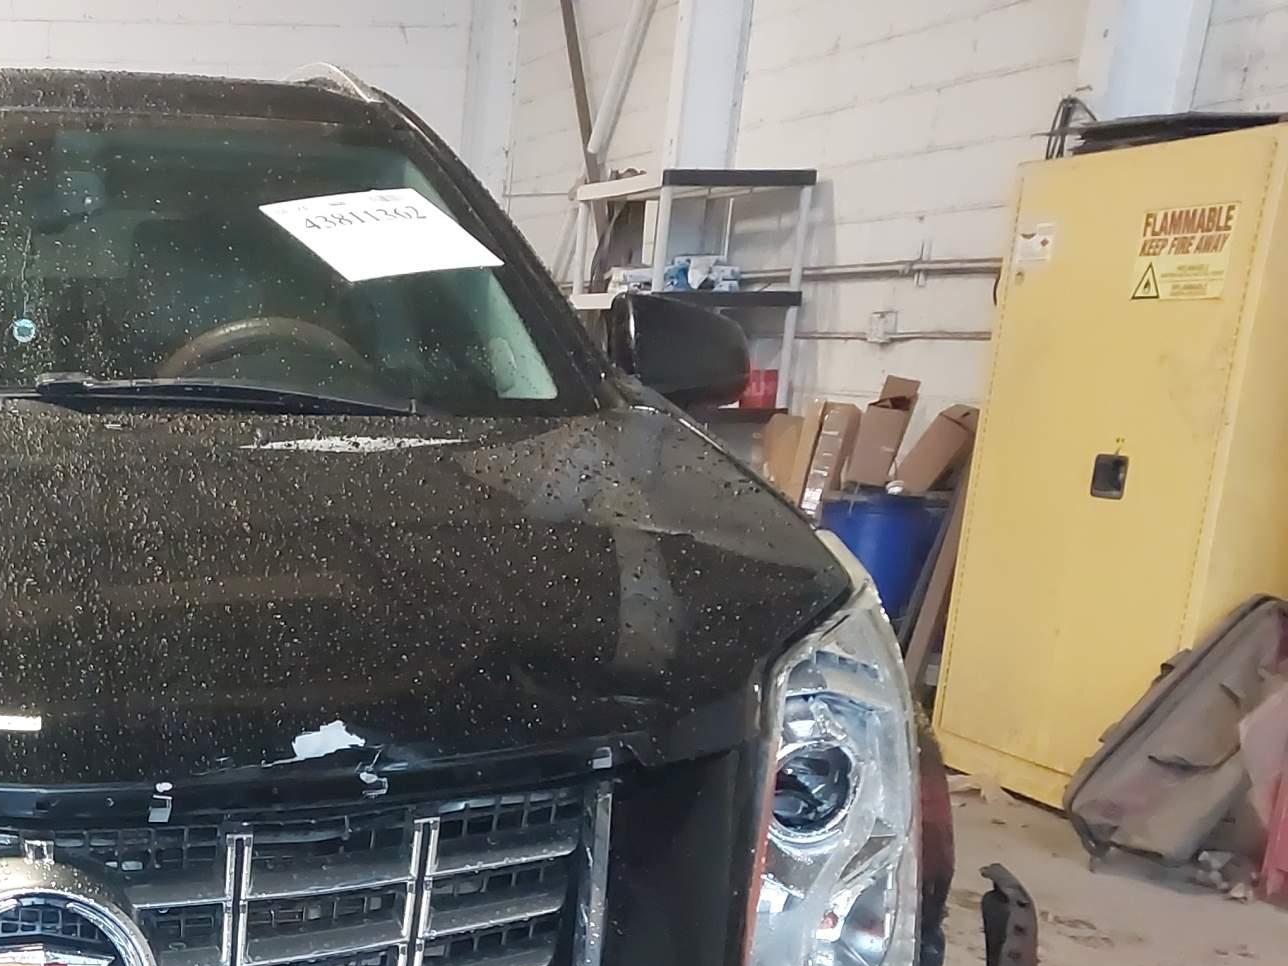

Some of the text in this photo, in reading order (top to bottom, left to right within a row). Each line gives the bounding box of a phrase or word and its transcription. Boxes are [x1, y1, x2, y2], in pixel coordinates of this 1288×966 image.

[305, 206, 427, 230] 43811362
[1143, 204, 1236, 238] FLAMMABLE
[1139, 233, 1231, 257] KEEP FIRE AWAY
